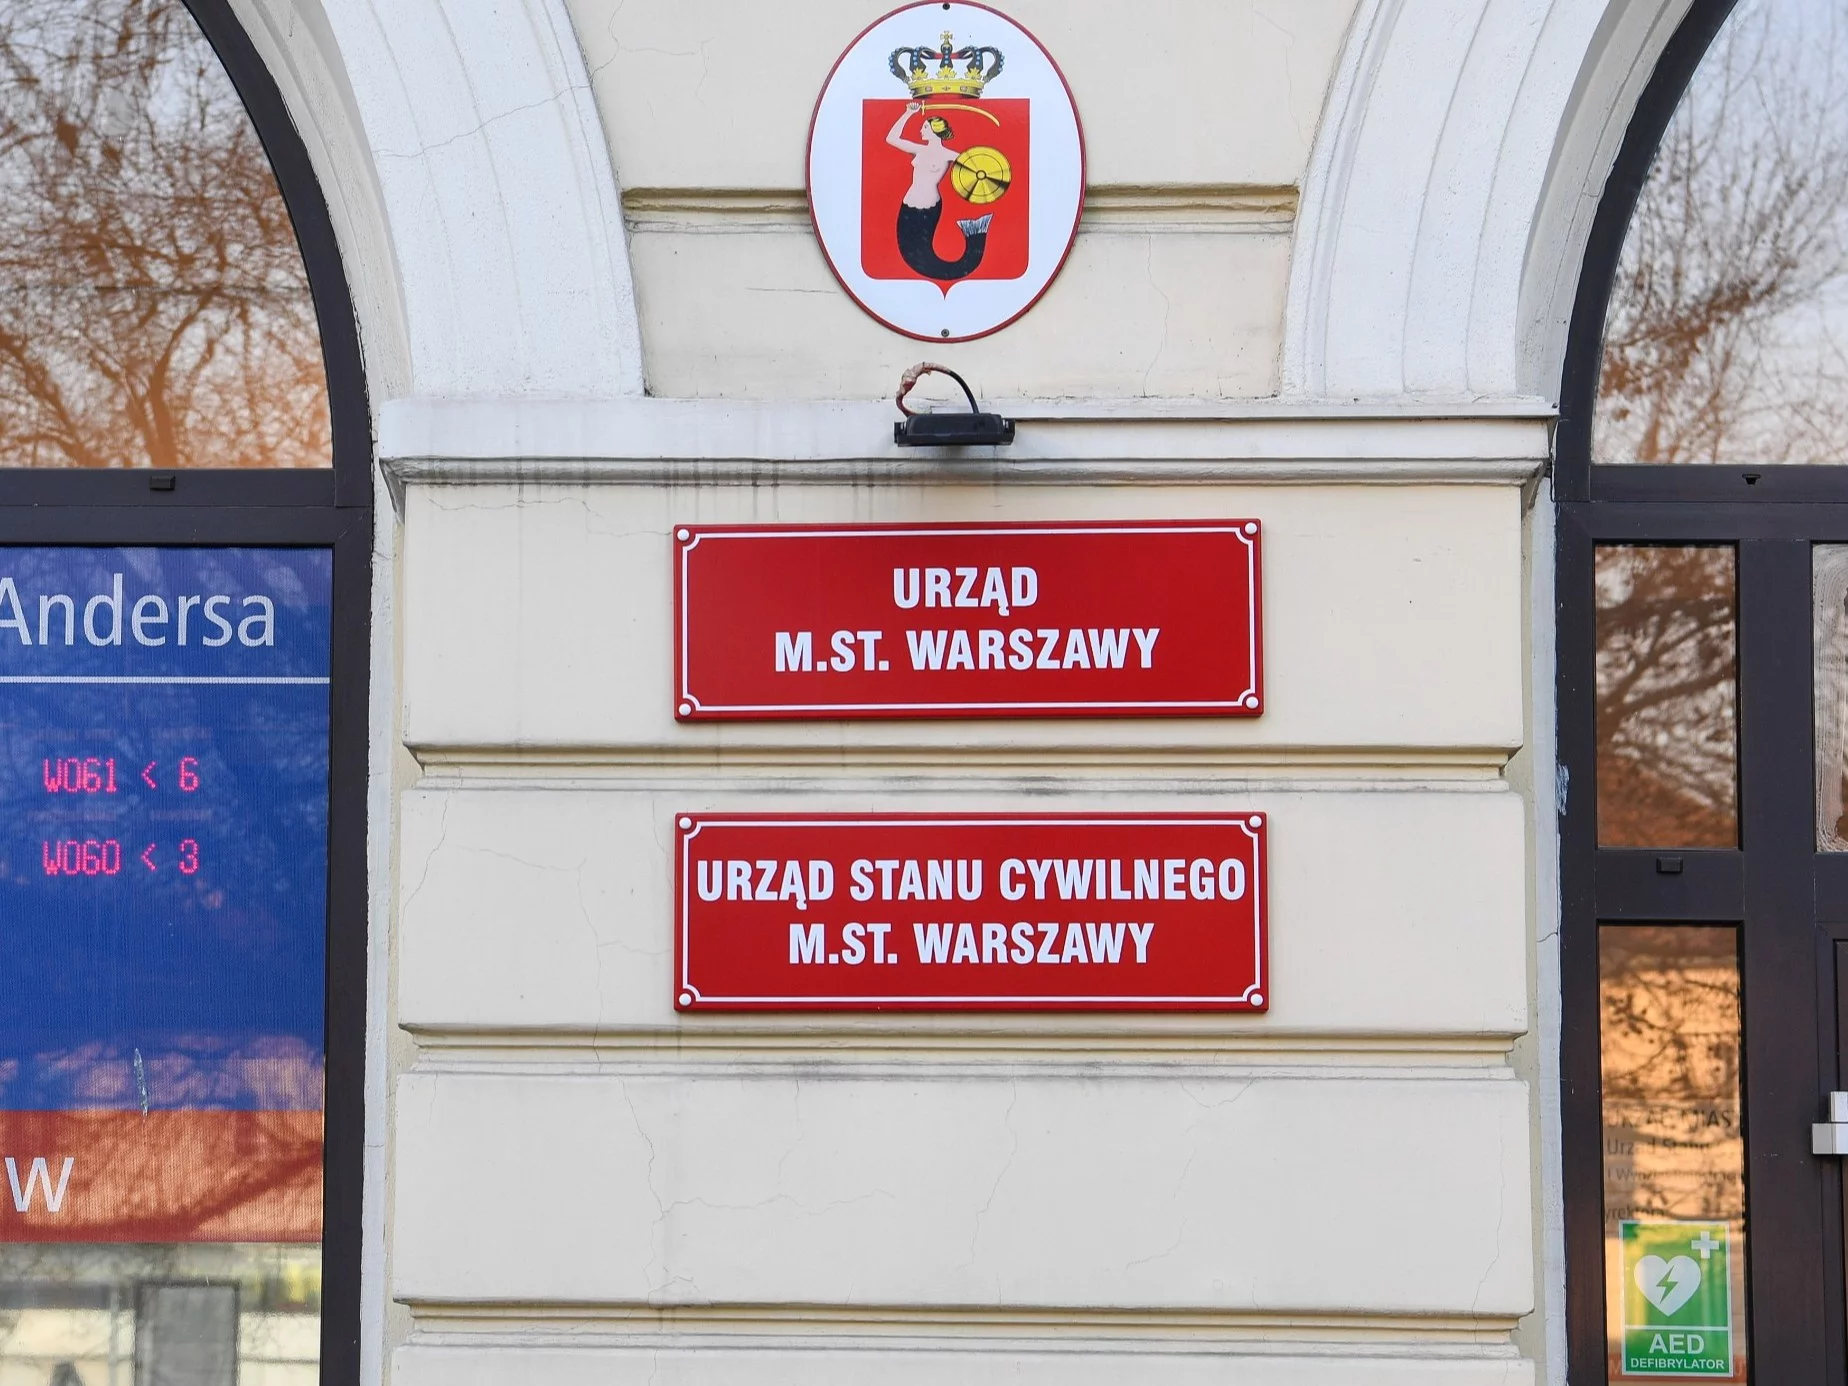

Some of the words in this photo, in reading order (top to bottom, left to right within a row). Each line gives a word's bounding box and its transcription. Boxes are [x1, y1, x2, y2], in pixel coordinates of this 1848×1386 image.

[0, 572, 275, 647] Andersa
[893, 566, 1038, 616] URZĄD
[775, 630, 890, 672] M.ST.
[905, 628, 1160, 671] WARSZAWY
[179, 757, 199, 791] 6
[179, 839, 199, 874] 3
[697, 859, 834, 911] URZĄD
[849, 859, 983, 902] STANU
[999, 858, 1246, 901] CYWILNEGO
[789, 922, 898, 965] M.ST.
[912, 921, 1155, 965] WARSZAWY
[1630, 1357, 1725, 1370] DEFIBRYLATOR
[1648, 1333, 1705, 1355] AED
